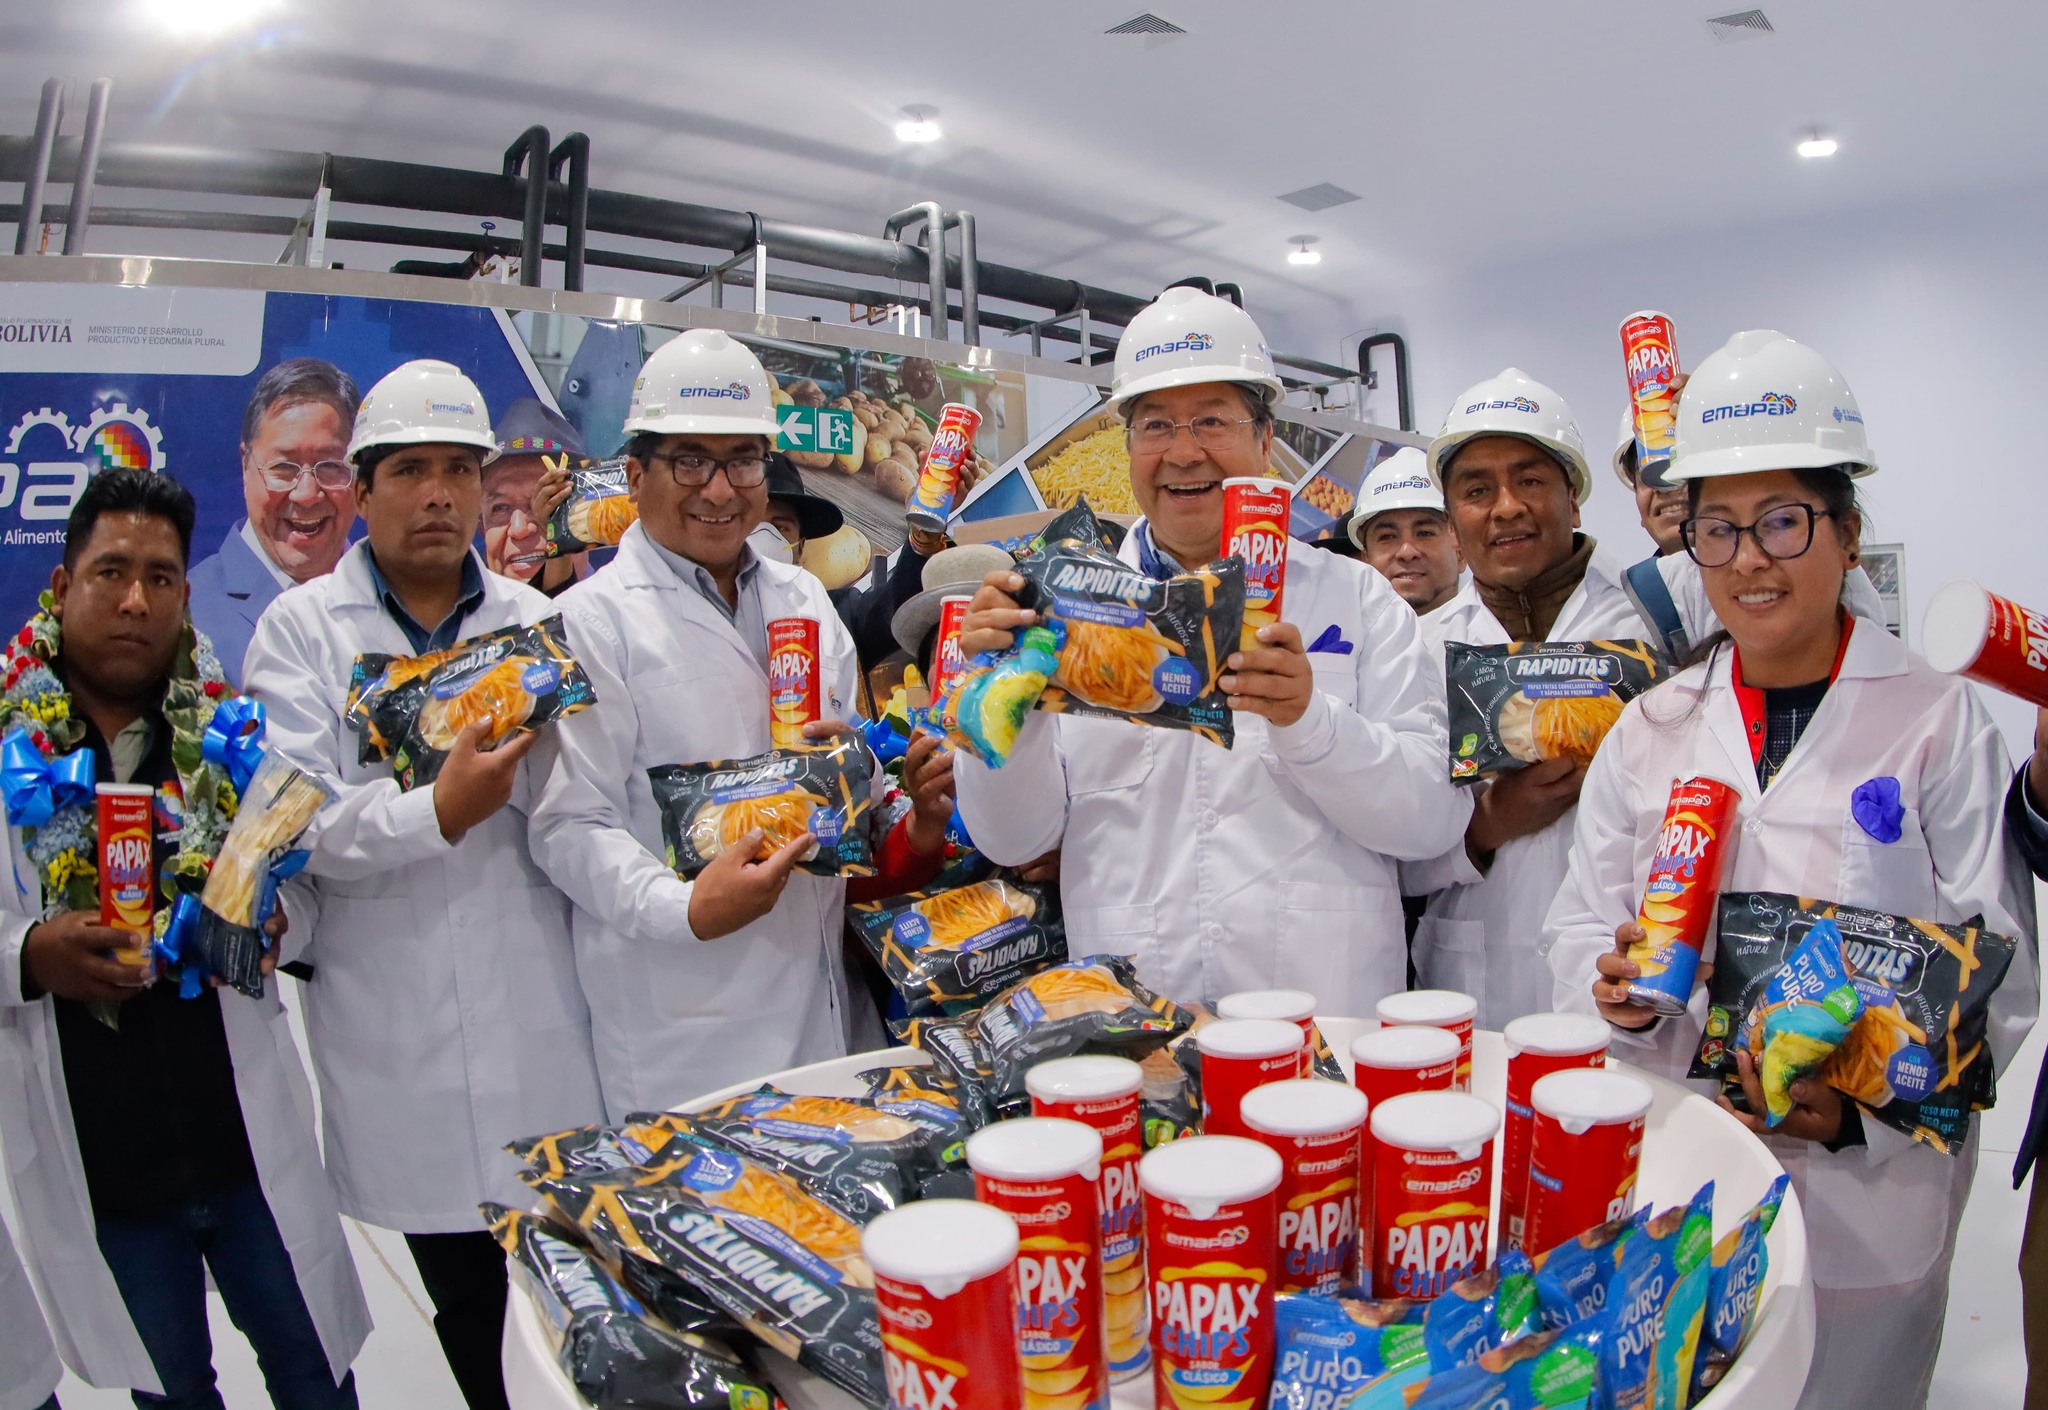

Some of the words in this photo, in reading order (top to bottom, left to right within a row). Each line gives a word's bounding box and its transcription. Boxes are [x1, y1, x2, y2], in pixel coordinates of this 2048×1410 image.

[88, 325, 136, 336] MINISTERIO
[137, 327, 149, 336] DE
[150, 327, 204, 337] DESARROLLO
[87, 335, 140, 345] PRODUCTIVO
[142, 336, 147, 345] Y
[148, 336, 194, 346] ECONOMÍA
[194, 337, 227, 347] PLURAL
[1136, 340, 1204, 361] emapa
[1628, 347, 1671, 378] PAPAX
[1632, 366, 1670, 387] CHIPS
[680, 387, 743, 401] emapa
[431, 403, 470, 415] emapa
[1466, 399, 1531, 414] emapa
[1702, 402, 1785, 424] emapa
[935, 430, 967, 452] PAPAX
[1373, 480, 1425, 495] emapa
[1229, 533, 1286, 568] PAPAX
[1244, 562, 1280, 584] HIPS
[1052, 563, 1153, 602] RAPIDITAS
[1246, 588, 1268, 598] LÁSICO
[1072, 601, 1091, 610] FRITAS
[769, 652, 811, 680] PAPAX
[1516, 657, 1611, 678] RAPIDITAS
[1161, 671, 1192, 685] MENOS
[1471, 672, 1497, 688] NATURAL
[1542, 683, 1557, 691] FRITAS
[1586, 682, 1604, 690] FÁCILES
[1161, 682, 1192, 696] ACEITE
[1207, 709, 1224, 720] NETO
[710, 758, 799, 790] RAPIDITAS
[816, 828, 838, 838] ACEITE
[106, 839, 151, 872] PAPAX
[1652, 881, 1677, 891] CLÁSICO
[898, 917, 921, 930] ACEITE
[1835, 911, 1881, 928] emapa
[902, 925, 925, 938] MENOS
[967, 933, 1039, 980] RAPIDITAS
[1736, 945, 1770, 957] NATURAL
[1794, 953, 1825, 995] PURO
[1864, 985, 1889, 998] FÁCILES
[1914, 993, 1936, 1035] DELICIOSAS
[1897, 1060, 1929, 1079] MENOS
[1894, 1073, 1926, 1090] ACEITE
[1920, 1104, 1939, 1116] PESO
[1939, 1107, 1960, 1118] NETO
[1406, 1178, 1473, 1192] emapa
[1165, 1232, 1238, 1249] emapa
[1388, 1221, 1486, 1279] PAPAX
[667, 1212, 832, 1318] RAPIDITAS
[1155, 1281, 1262, 1341] PAPAX
[1714, 1279, 1757, 1339] PURÉ
[1161, 1326, 1252, 1361] CHIPS
[1616, 1303, 1667, 1370] PURÉ
[1021, 1339, 1061, 1354] LÁSICO
[1188, 1360, 1220, 1371] SABOR
[1282, 1350, 1362, 1390] PURO
[1181, 1370, 1230, 1384] CLÁSICO
